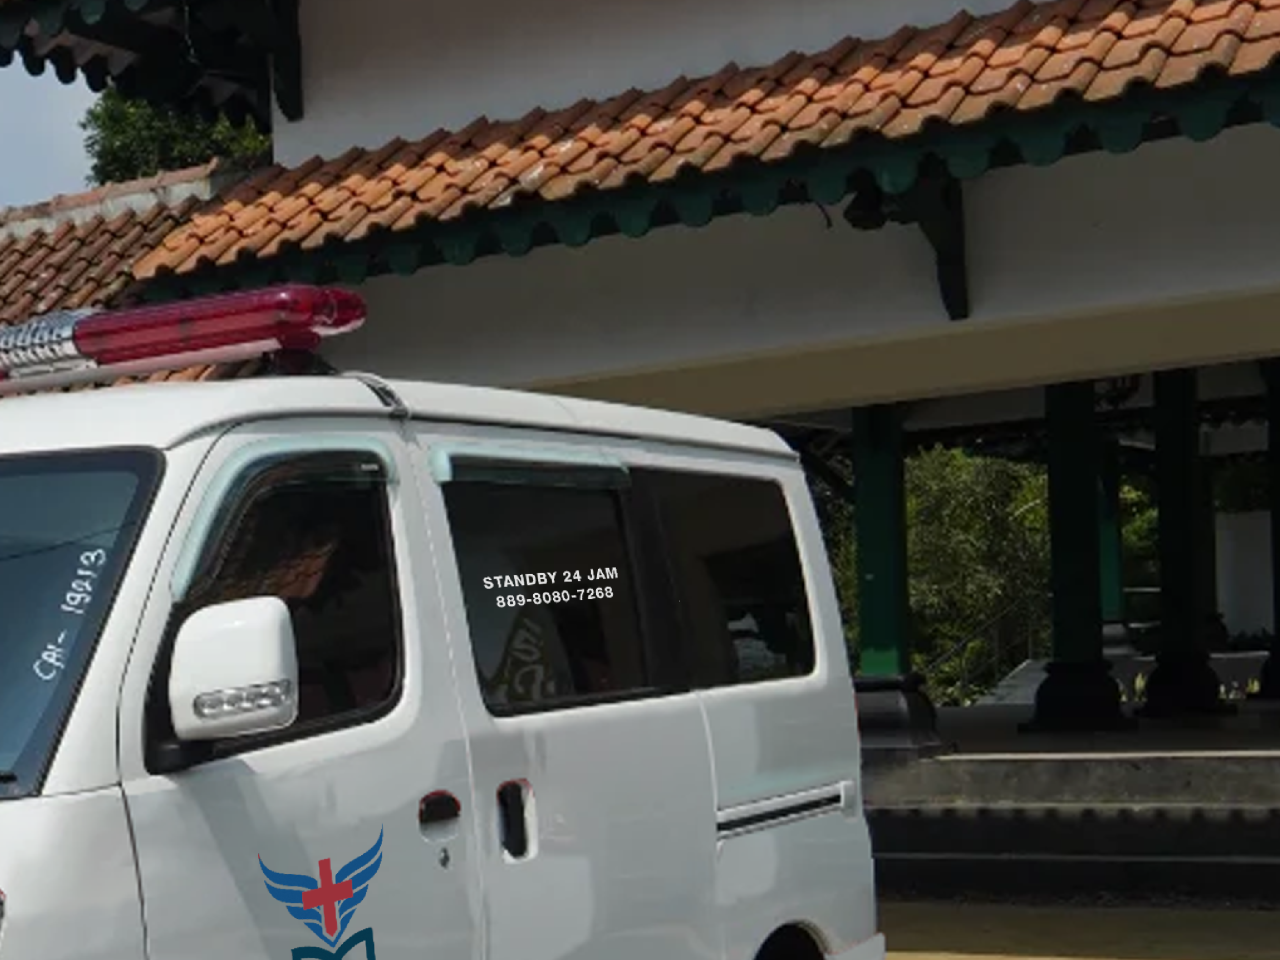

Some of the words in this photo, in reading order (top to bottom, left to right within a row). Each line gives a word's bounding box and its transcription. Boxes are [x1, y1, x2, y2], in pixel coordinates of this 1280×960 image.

[483, 571, 557, 589] STANDBY
[562, 570, 582, 583] 24
[587, 567, 618, 580] JAM
[496, 586, 614, 608] 889-8080-7268
